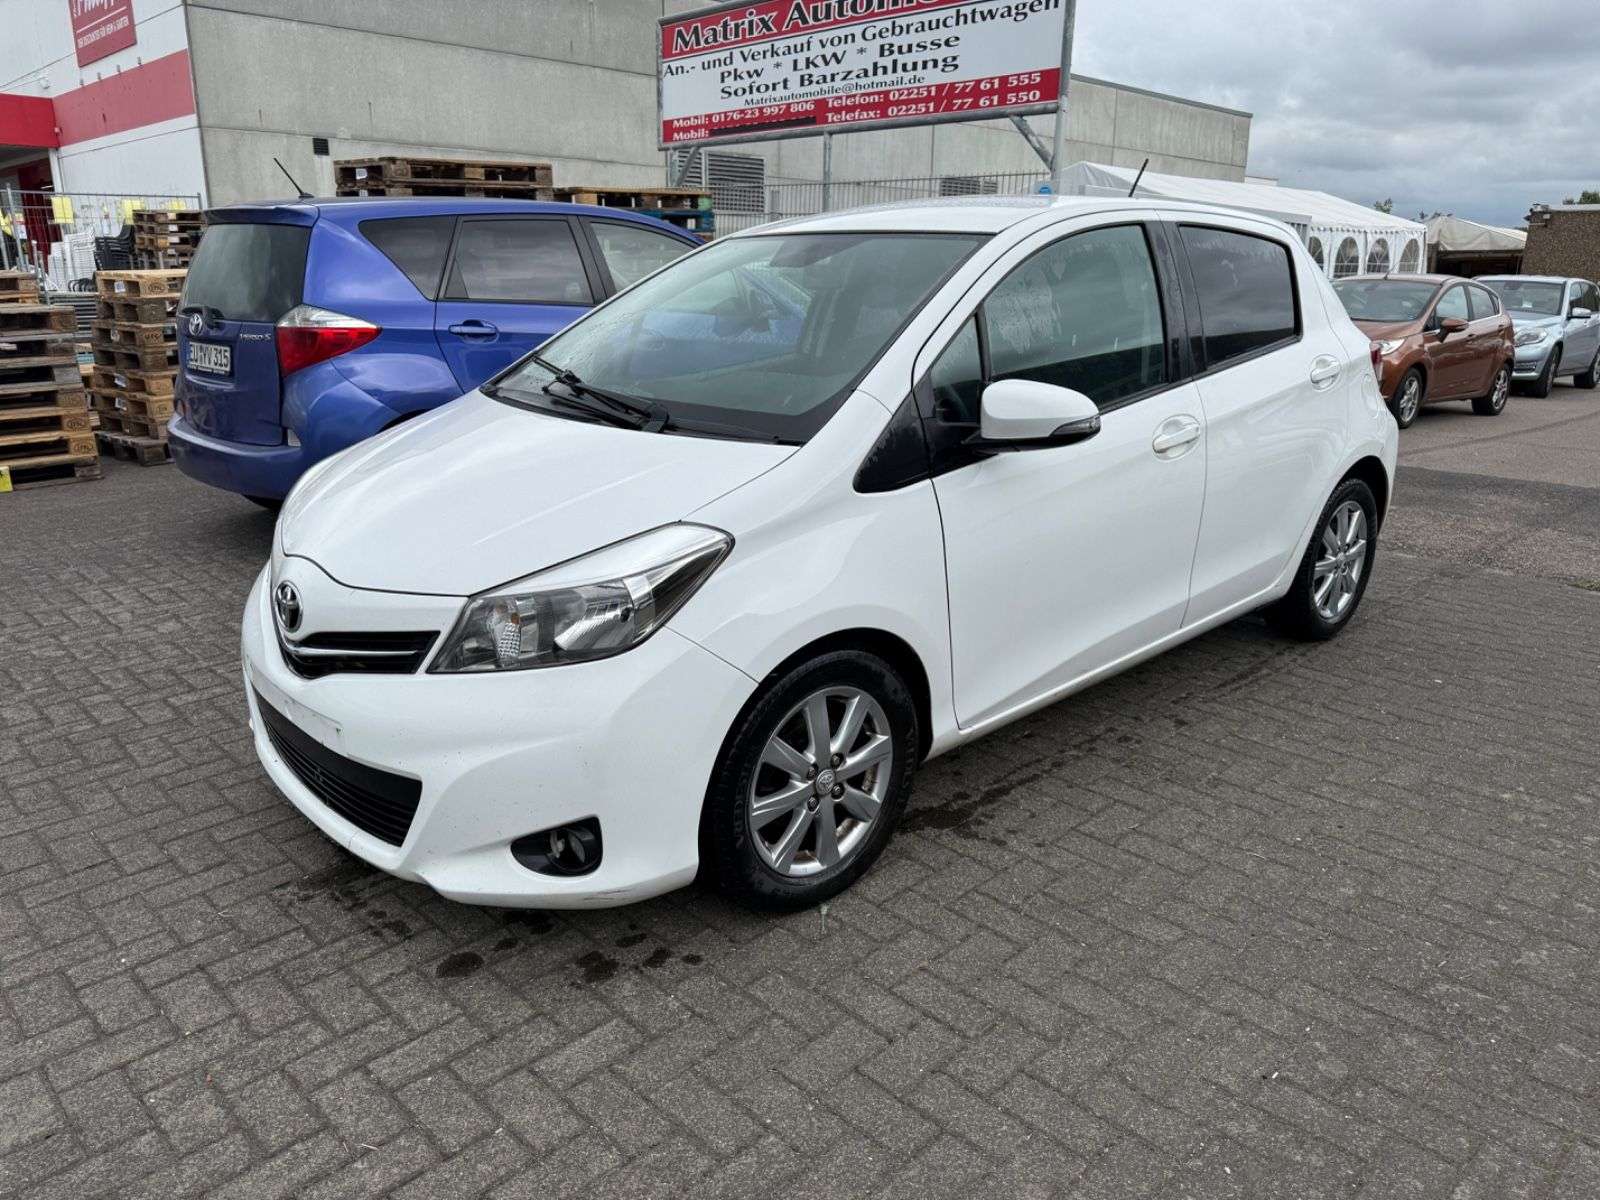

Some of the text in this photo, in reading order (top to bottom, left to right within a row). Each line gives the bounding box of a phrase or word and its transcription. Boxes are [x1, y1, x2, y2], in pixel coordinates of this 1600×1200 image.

[672, 9, 779, 54] Matrix
[701, 53, 734, 71] und
[740, 35, 812, 64] Verkauf
[819, 32, 856, 49] von
[861, 0, 1060, 42] Gebrauchtwagen
[719, 36, 960, 84] Pkw LKW Busse
[720, 54, 960, 100] Sofort Barzahlung
[744, 75, 925, 107] Matrixautomobile@hotmail.de
[825, 108, 881, 123] Telefax:
[887, 101, 935, 117] 02251
[952, 97, 973, 109] 77
[978, 95, 999, 107] 61
[1005, 90, 1041, 104] 550
[826, 93, 884, 108] Telefon:
[889, 86, 937, 101] 02251
[954, 81, 975, 92] 77
[980, 79, 1000, 91] 61
[1007, 72, 1041, 86] 555
[672, 115, 709, 129] Mobil:
[712, 109, 759, 123] 0176-23
[762, 105, 785, 116] 997
[790, 101, 815, 112] 806
[672, 130, 709, 142] Mobil:
